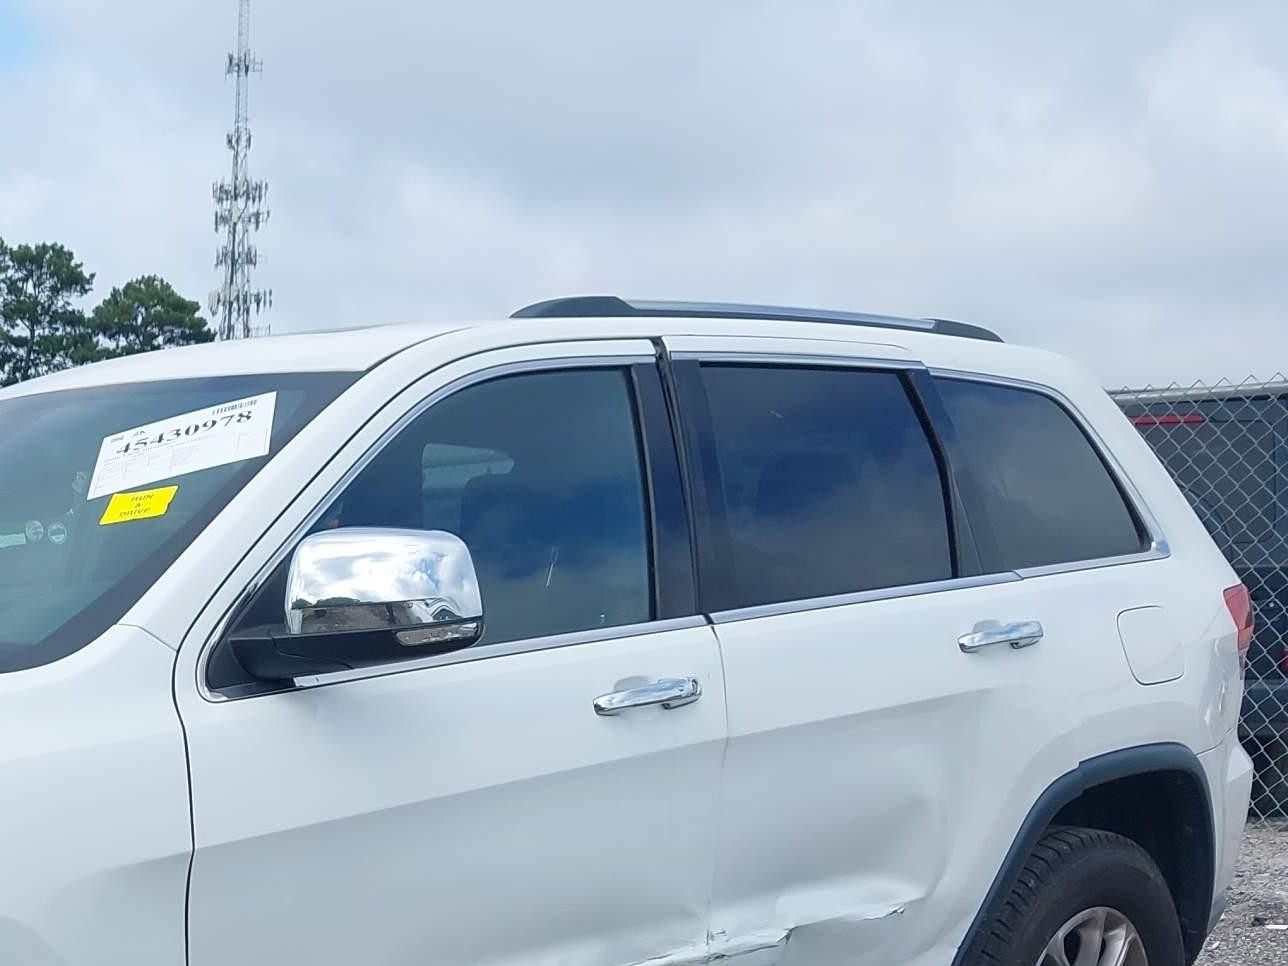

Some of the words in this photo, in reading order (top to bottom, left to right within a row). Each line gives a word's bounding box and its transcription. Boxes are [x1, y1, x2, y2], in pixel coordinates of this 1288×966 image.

[116, 410, 252, 454] 45430978
[131, 494, 154, 502] RUN
[119, 507, 152, 518] DRIVE
